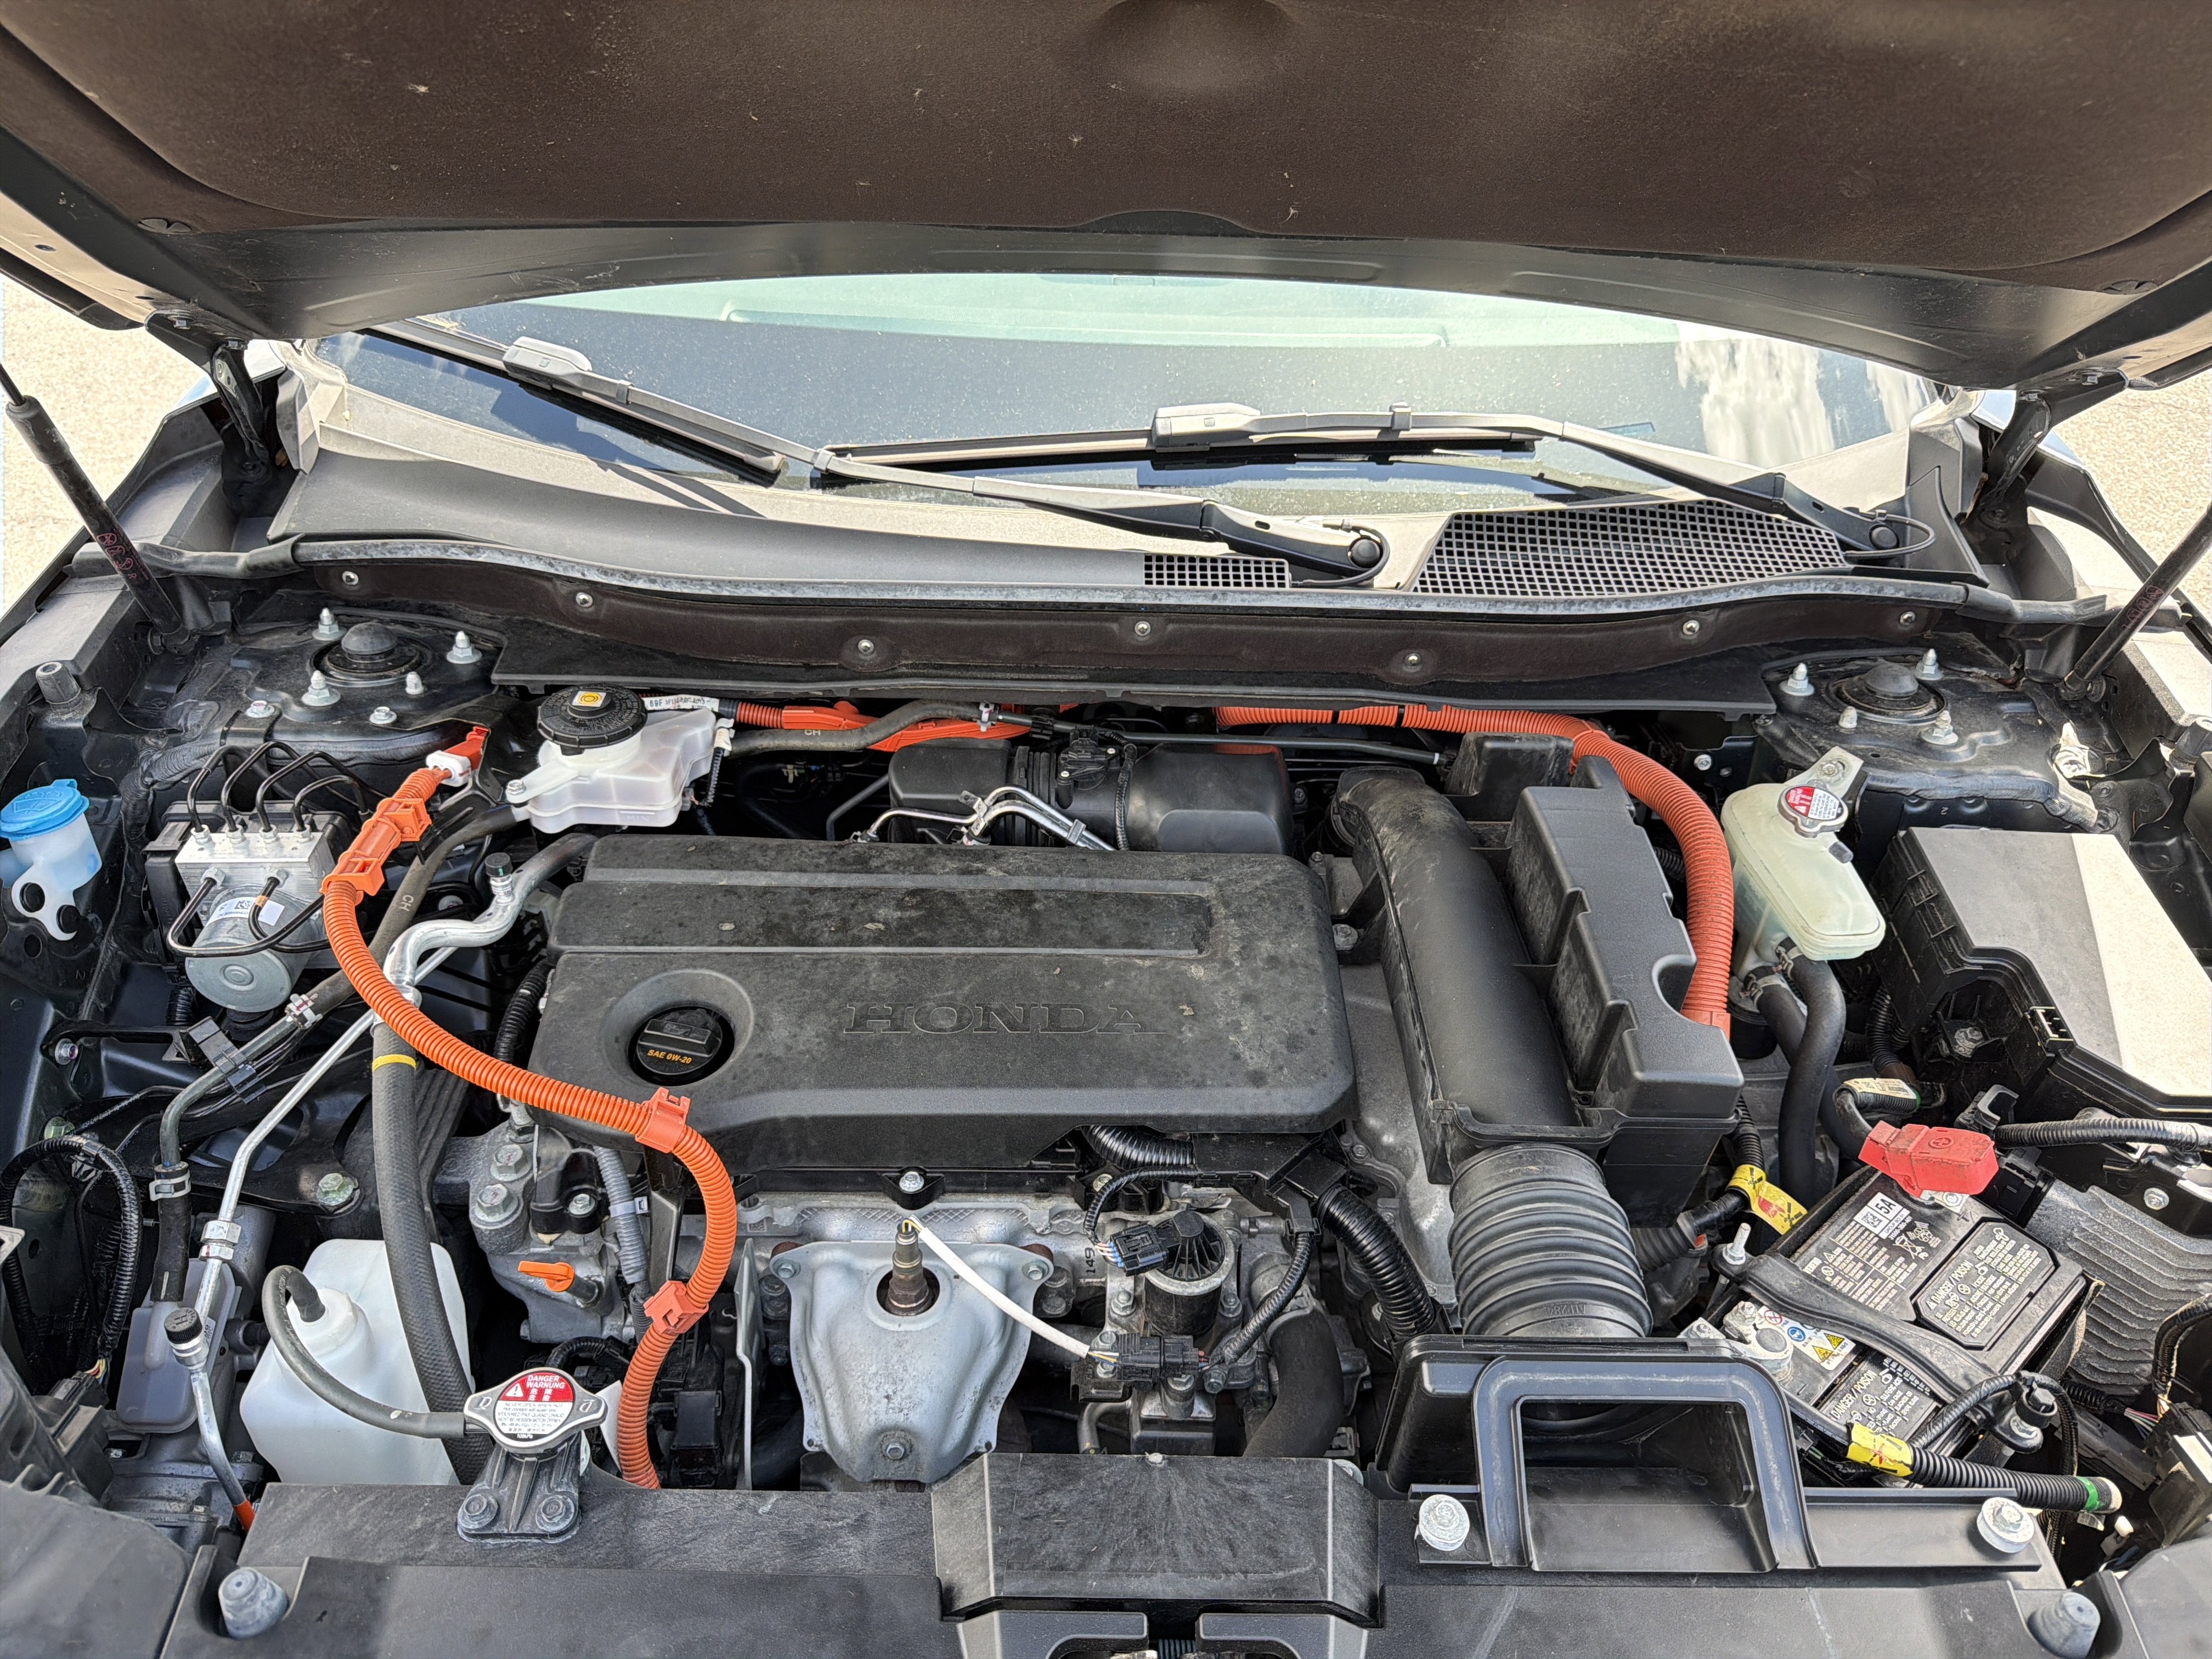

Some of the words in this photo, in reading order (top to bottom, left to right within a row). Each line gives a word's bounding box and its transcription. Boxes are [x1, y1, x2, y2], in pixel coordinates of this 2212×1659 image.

[398, 894, 414, 912] CH
[843, 1002, 1167, 1035] HONDA
[647, 1049, 667, 1059] SAE
[666, 1053, 692, 1064] 0W-20
[1875, 1198, 1896, 1215] 5A
[1931, 1280, 1954, 1304] DANGER
[1953, 1259, 1973, 1282] POISON
[526, 1381, 566, 1389] WARNUNG
[527, 1374, 560, 1383] DANGER
[1830, 1392, 1856, 1419] DANGER
[1854, 1369, 1877, 1393] POISON
